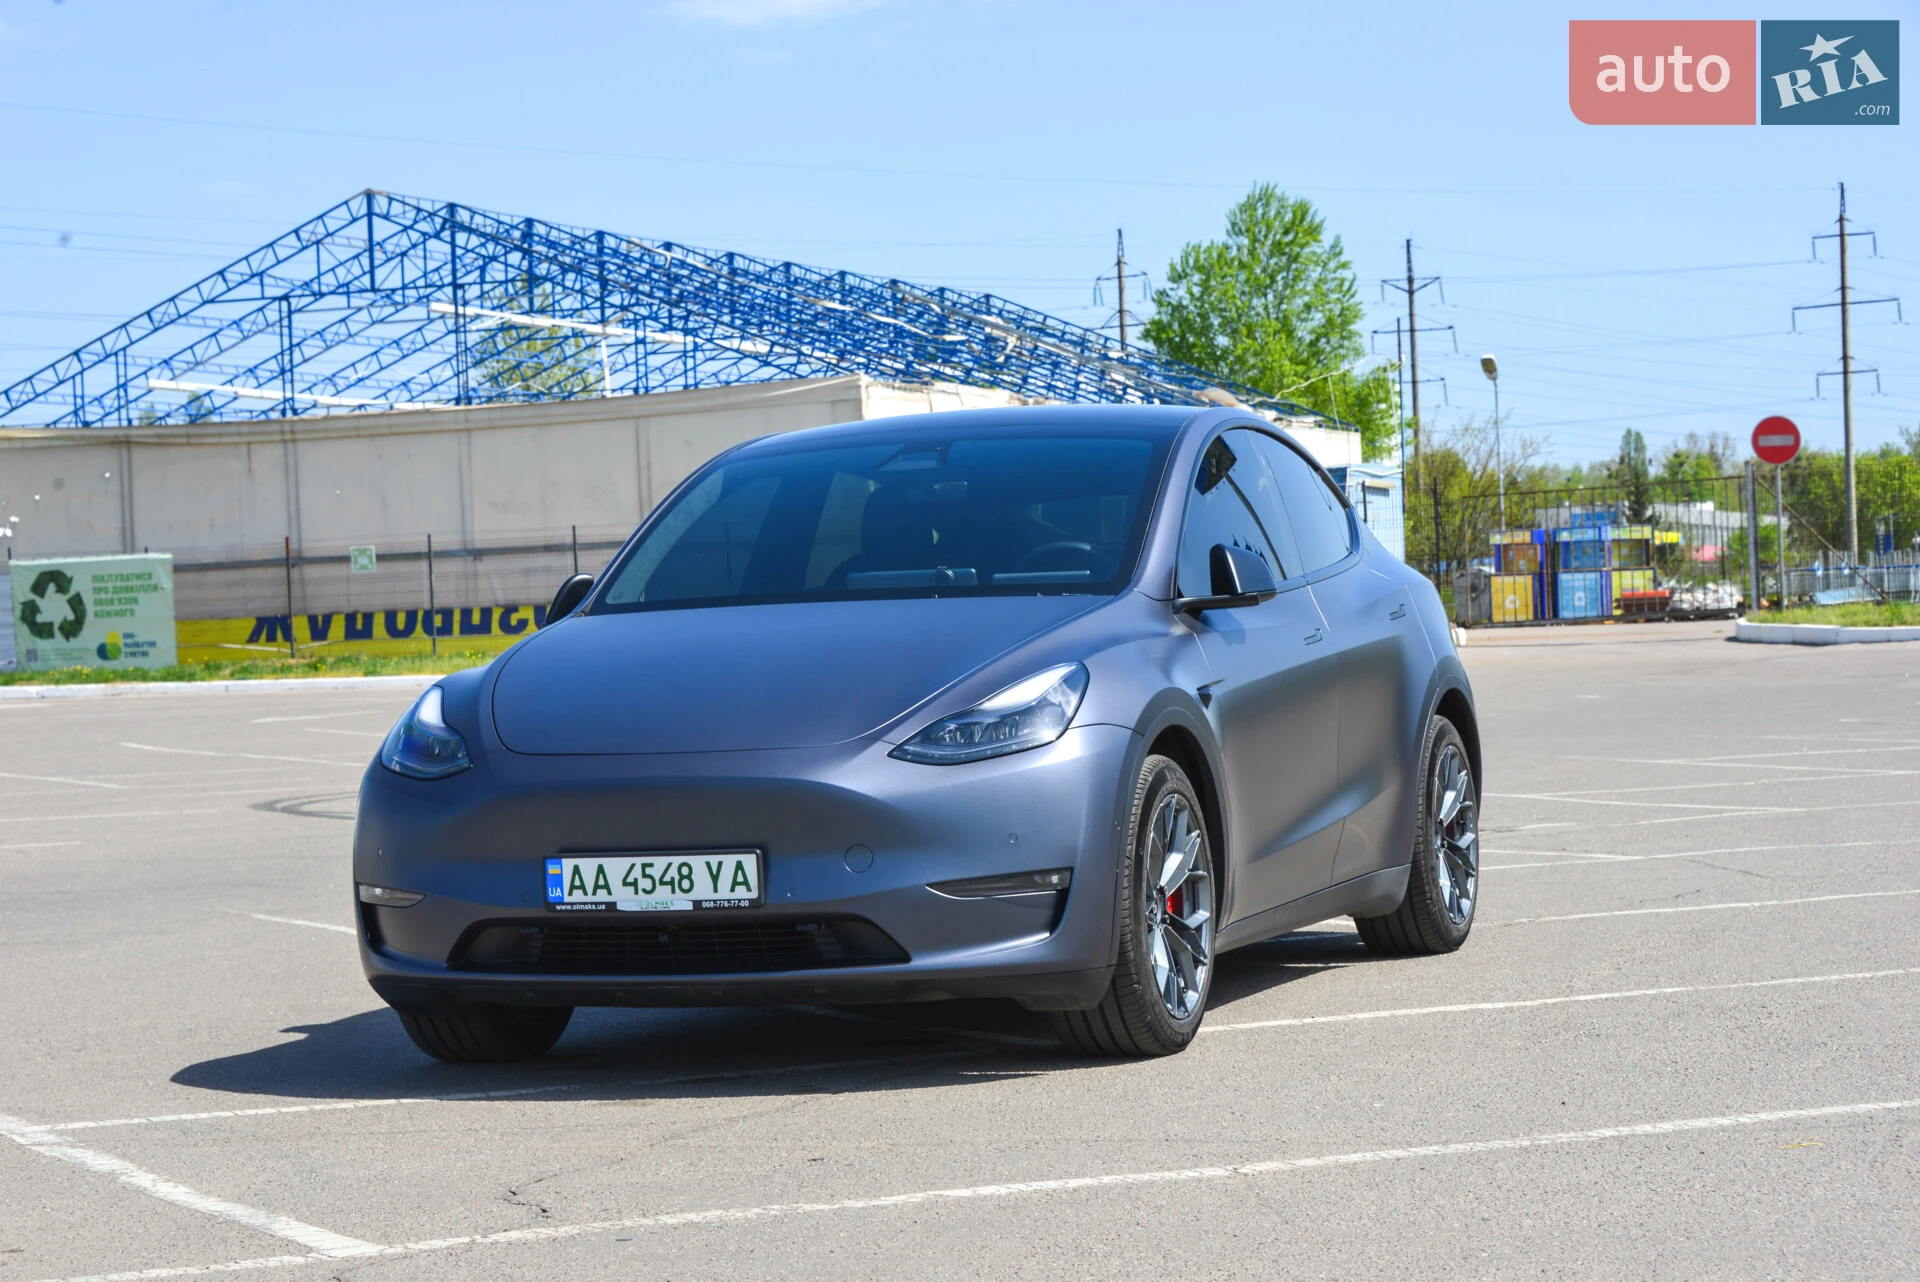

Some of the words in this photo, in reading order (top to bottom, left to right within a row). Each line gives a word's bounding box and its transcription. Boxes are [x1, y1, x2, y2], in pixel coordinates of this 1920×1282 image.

[92, 586, 109, 595] ПРО
[567, 864, 613, 897] AA
[621, 861, 695, 896] 4548
[704, 860, 753, 894] YA
[549, 887, 562, 898] UA
[555, 903, 606, 911] www.olmaks.ua
[701, 900, 749, 908] 068-776-77-00
